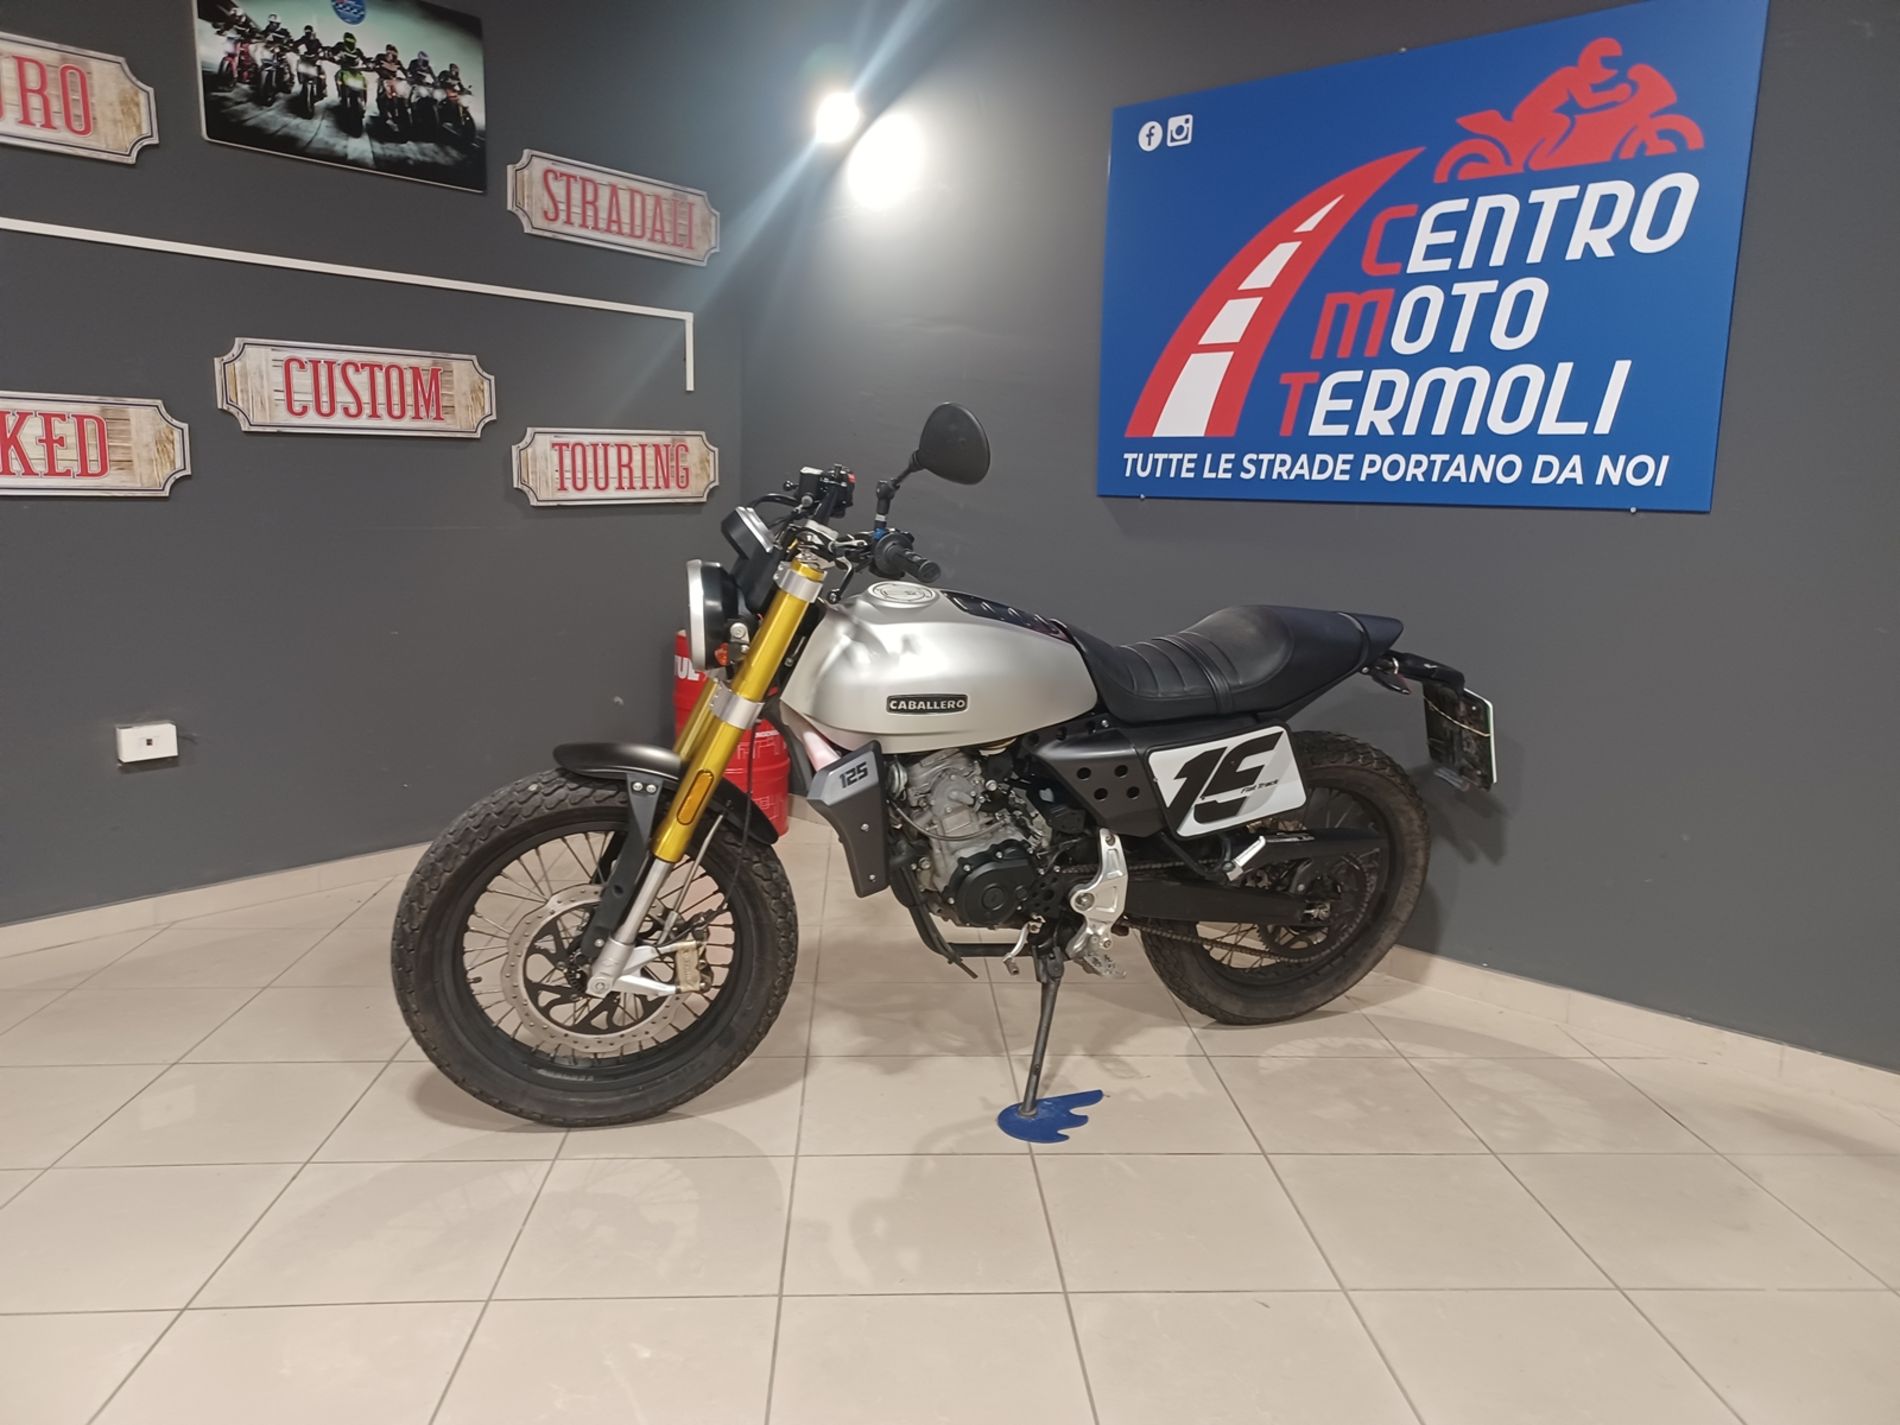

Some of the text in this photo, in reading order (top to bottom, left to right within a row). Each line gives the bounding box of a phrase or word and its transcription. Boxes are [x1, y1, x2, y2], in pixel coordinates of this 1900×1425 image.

[0, 55, 93, 137] RO
[542, 168, 696, 250] STRADALI
[1361, 172, 1700, 276] CENTRO
[1310, 277, 1550, 360] MOTO
[283, 357, 444, 421] CUSTOM
[1279, 360, 1632, 437] TERMOLI
[551, 442, 690, 491] TOURING
[1123, 453, 1670, 487] TUTTE LE STRADE PORTANO DA NOI
[889, 699, 966, 711] CABALLERO
[839, 762, 868, 788] 125
